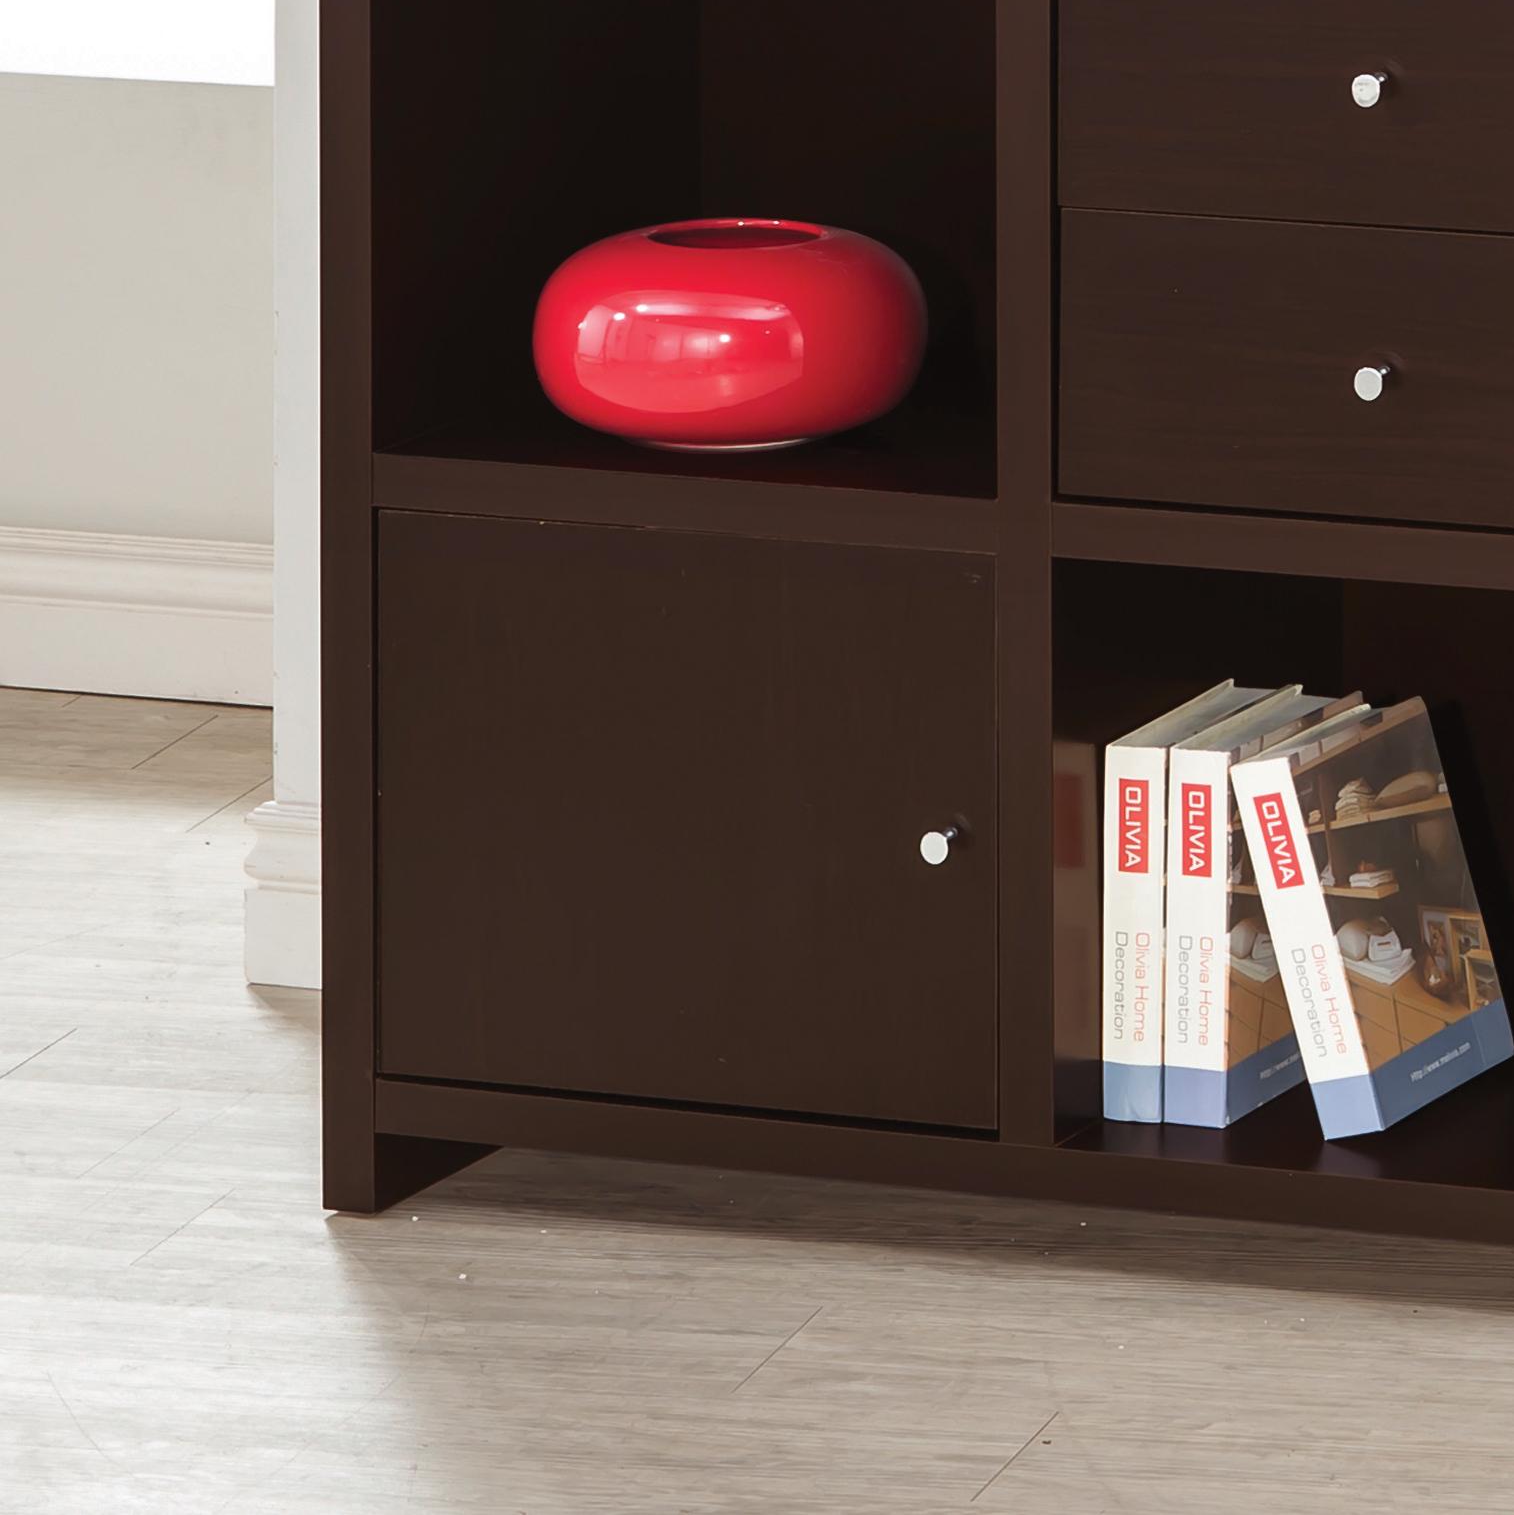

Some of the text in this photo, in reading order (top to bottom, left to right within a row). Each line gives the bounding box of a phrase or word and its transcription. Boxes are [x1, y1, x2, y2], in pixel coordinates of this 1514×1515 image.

[1124, 786, 1142, 867] OLIVIA
[1188, 790, 1206, 872] OLIVIA
[1261, 800, 1297, 884] OLIVIA
[1113, 931, 1129, 1040] Decoration
[1133, 932, 1151, 1042] Olivia Home
[1177, 935, 1193, 1044] Decoration
[1198, 936, 1214, 1047] Olivia Home
[1291, 948, 1328, 1058] Decoration
[1311, 943, 1348, 1054] Olivia Home
